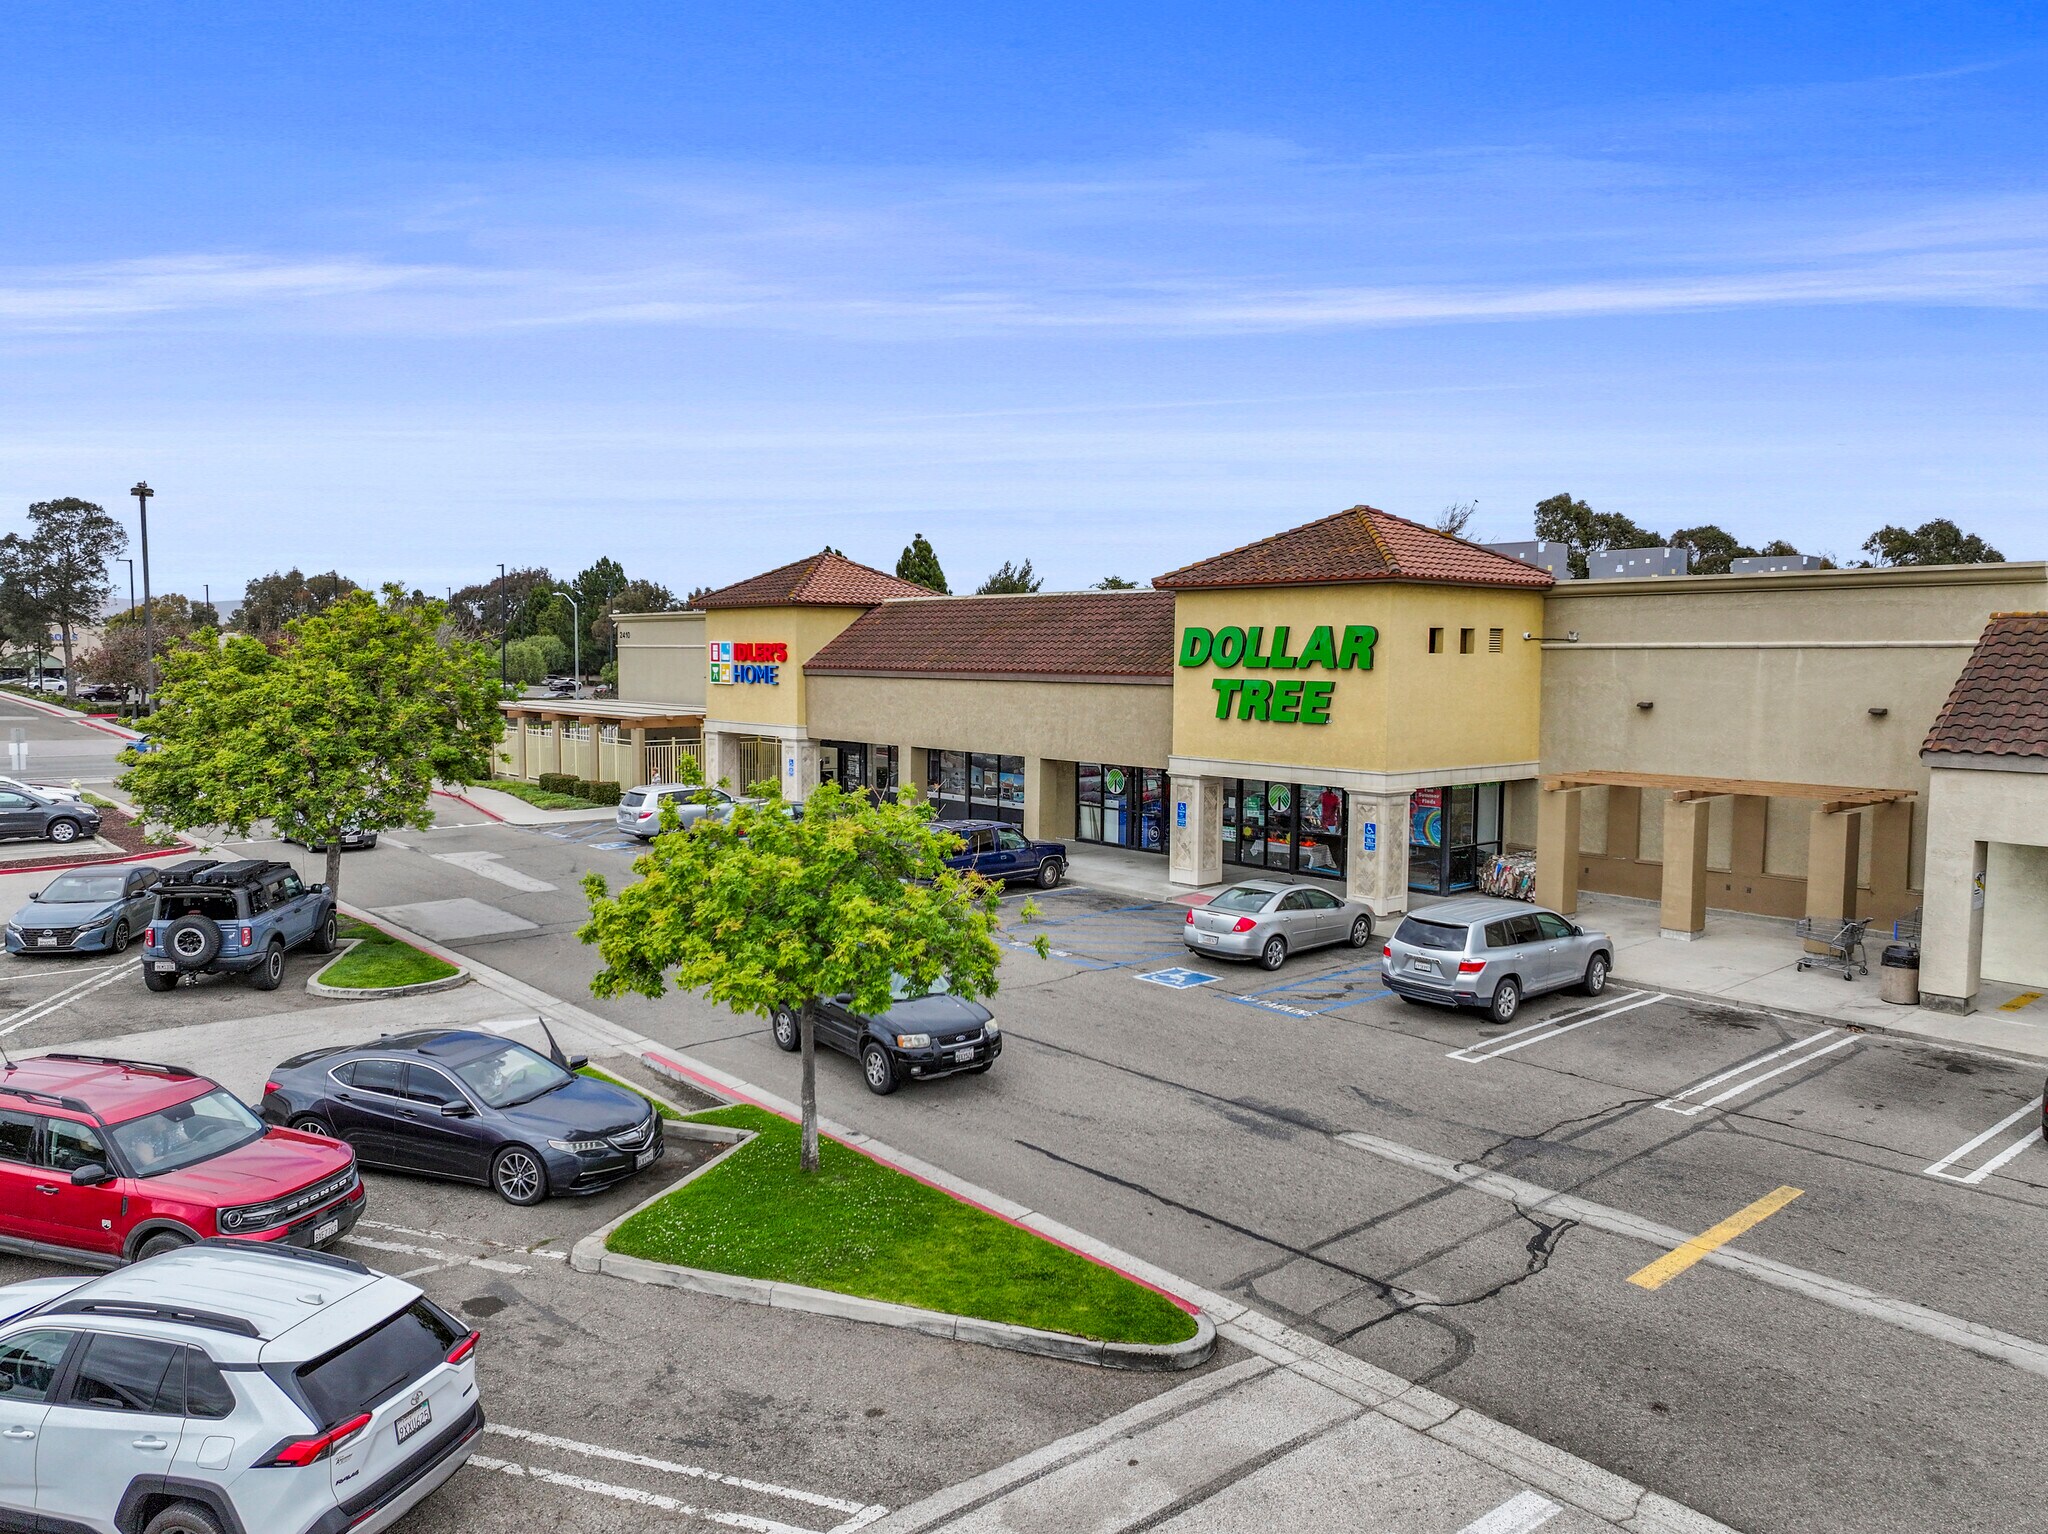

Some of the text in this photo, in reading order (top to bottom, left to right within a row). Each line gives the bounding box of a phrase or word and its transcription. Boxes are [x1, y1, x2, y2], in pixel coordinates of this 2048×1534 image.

[619, 631, 631, 639] 2410
[1179, 625, 1379, 670] DOLLAR
[734, 643, 788, 662] IDLER'S
[734, 665, 779, 685] HOME
[1212, 679, 1336, 724] TREE
[1256, 1000, 1318, 1017] PARKING
[287, 1178, 347, 1211] BRONCO
[399, 1409, 430, 1439] 9XXU625
